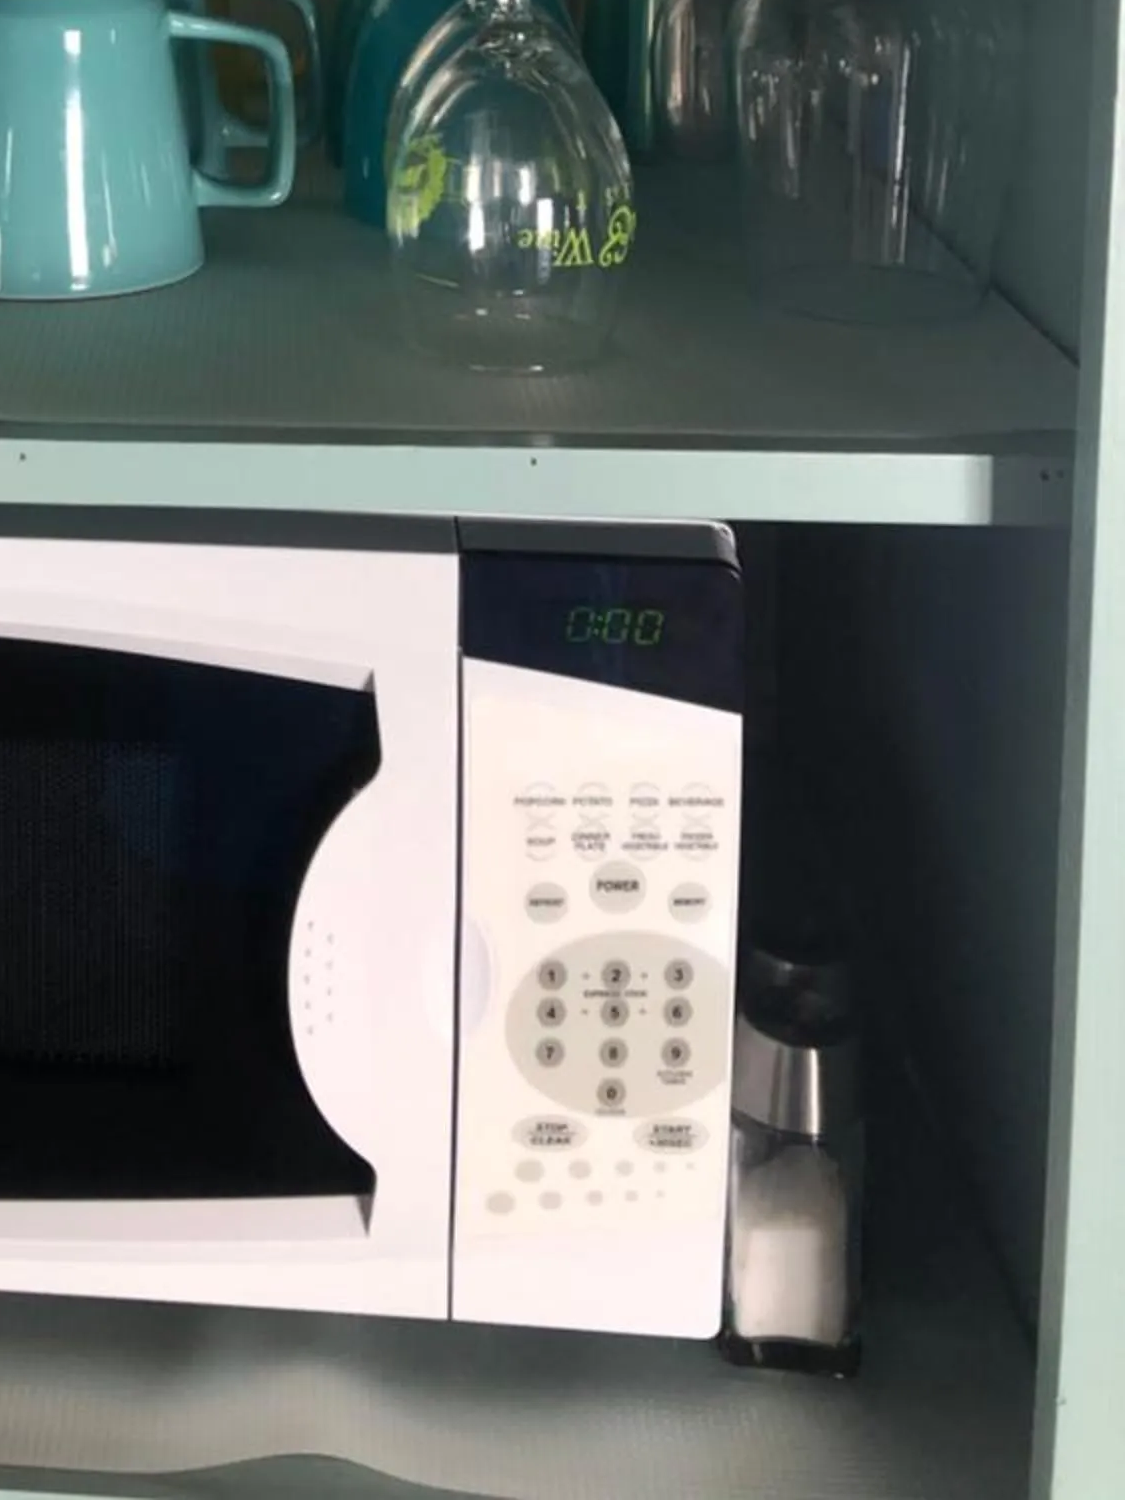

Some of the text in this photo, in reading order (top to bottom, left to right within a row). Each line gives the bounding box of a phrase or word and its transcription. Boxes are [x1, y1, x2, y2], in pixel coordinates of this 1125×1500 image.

[566, 608, 664, 644] 0:00
[596, 879, 640, 892] POWER
[547, 968, 556, 983] 1
[611, 968, 622, 983] 2
[674, 967, 684, 982] 3
[546, 1005, 556, 1019] 4
[611, 1005, 620, 1019] 5
[672, 1004, 683, 1019] 6
[545, 1045, 555, 1060] 7
[671, 1046, 682, 1060] 9
[606, 1086, 617, 1100] 0
[536, 1122, 569, 1132] STOP
[653, 1124, 692, 1134] START
